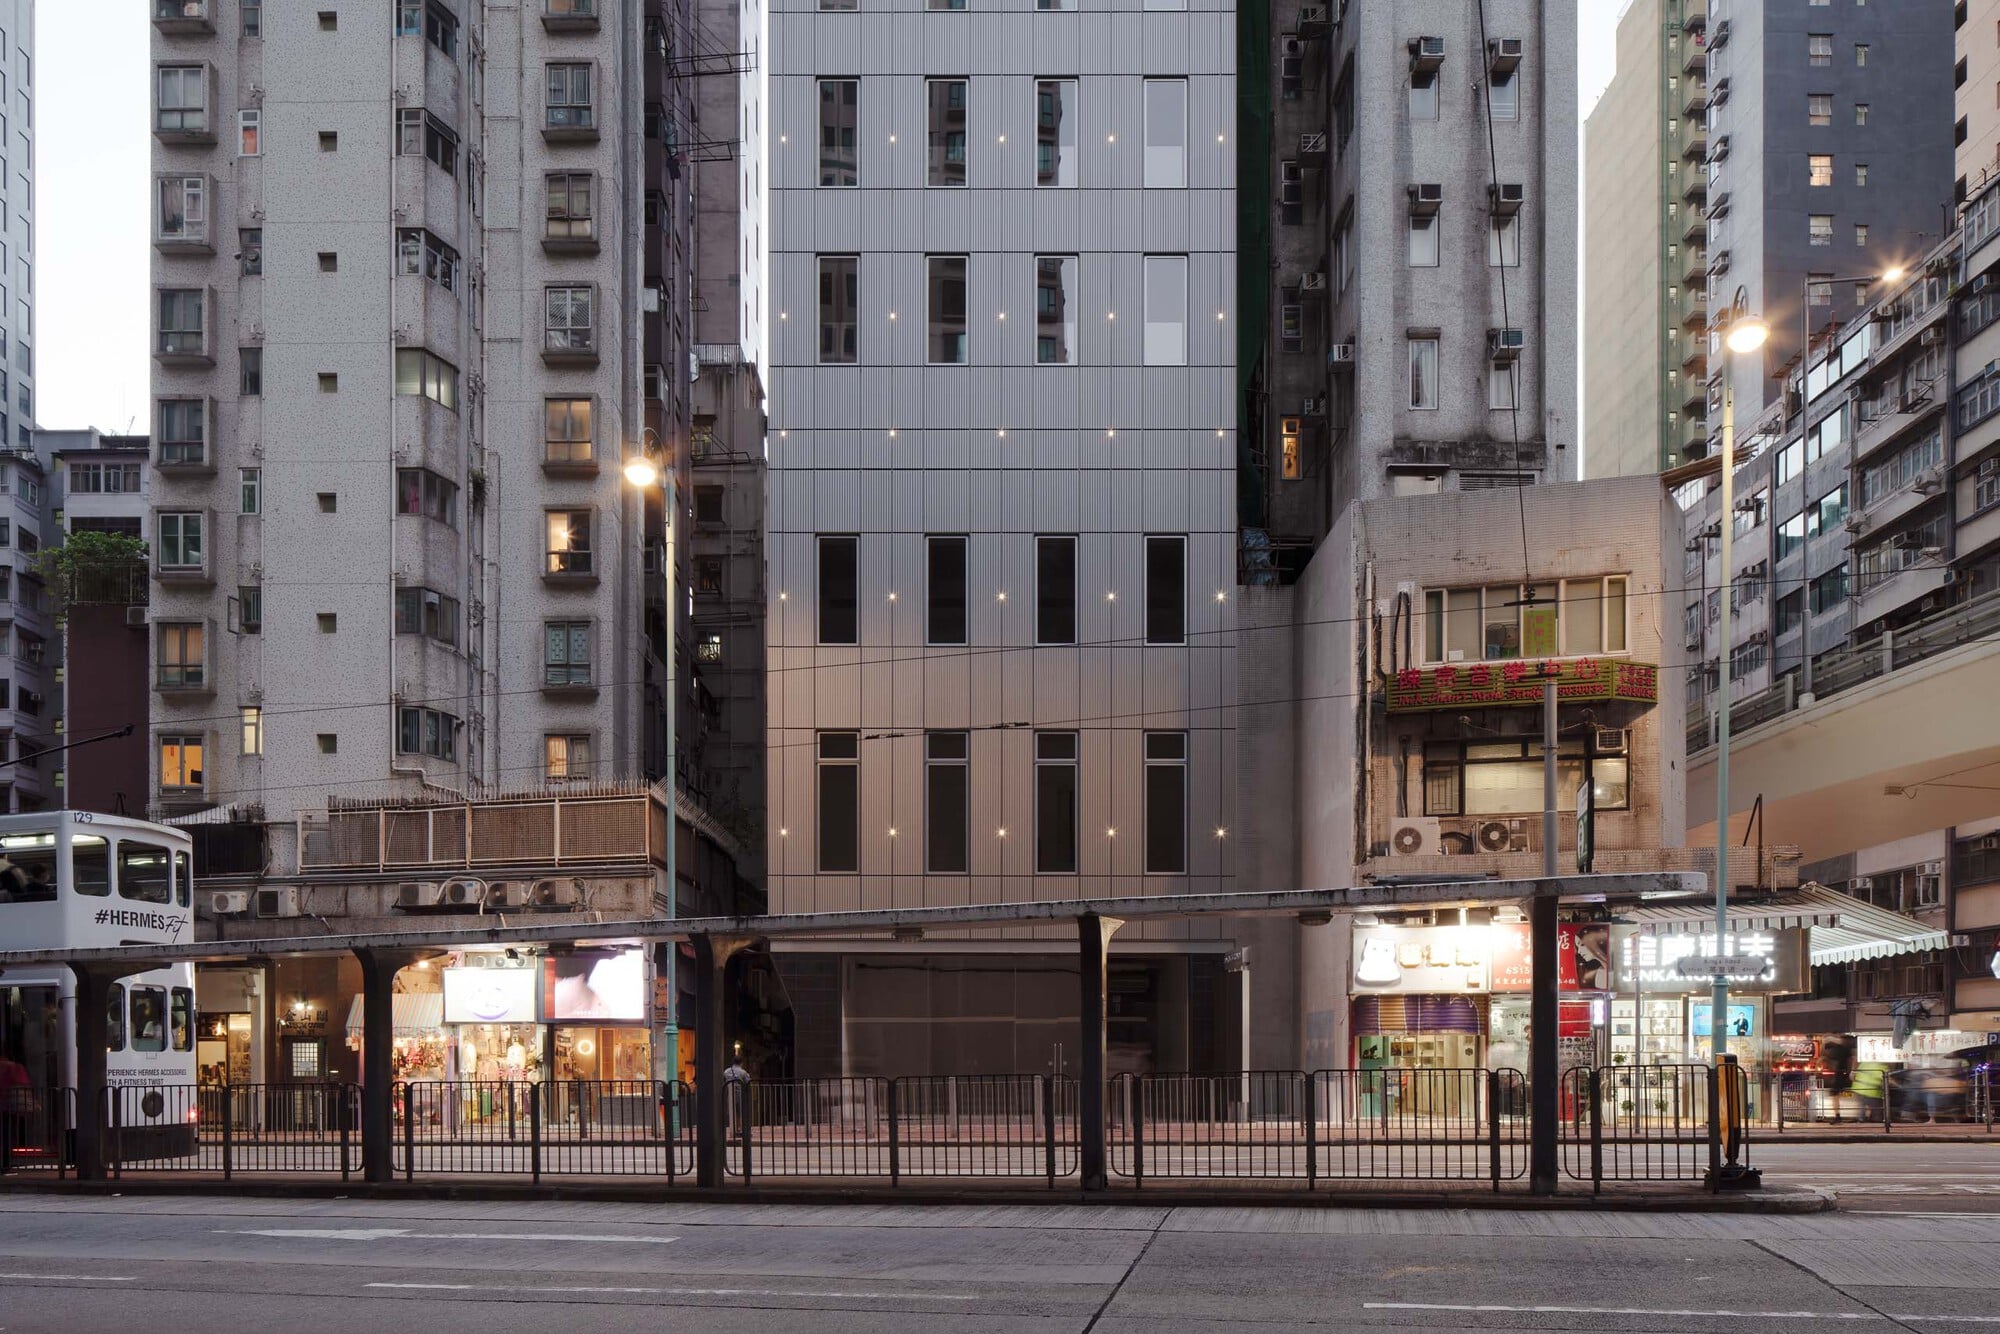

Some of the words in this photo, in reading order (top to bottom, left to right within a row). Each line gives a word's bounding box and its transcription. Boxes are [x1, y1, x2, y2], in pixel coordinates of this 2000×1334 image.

[74, 811, 93, 824] 129
[1989, 1034, 1998, 1046] P
[108, 1068, 137, 1076] PERIENCE
[108, 1078, 117, 1086] TH
